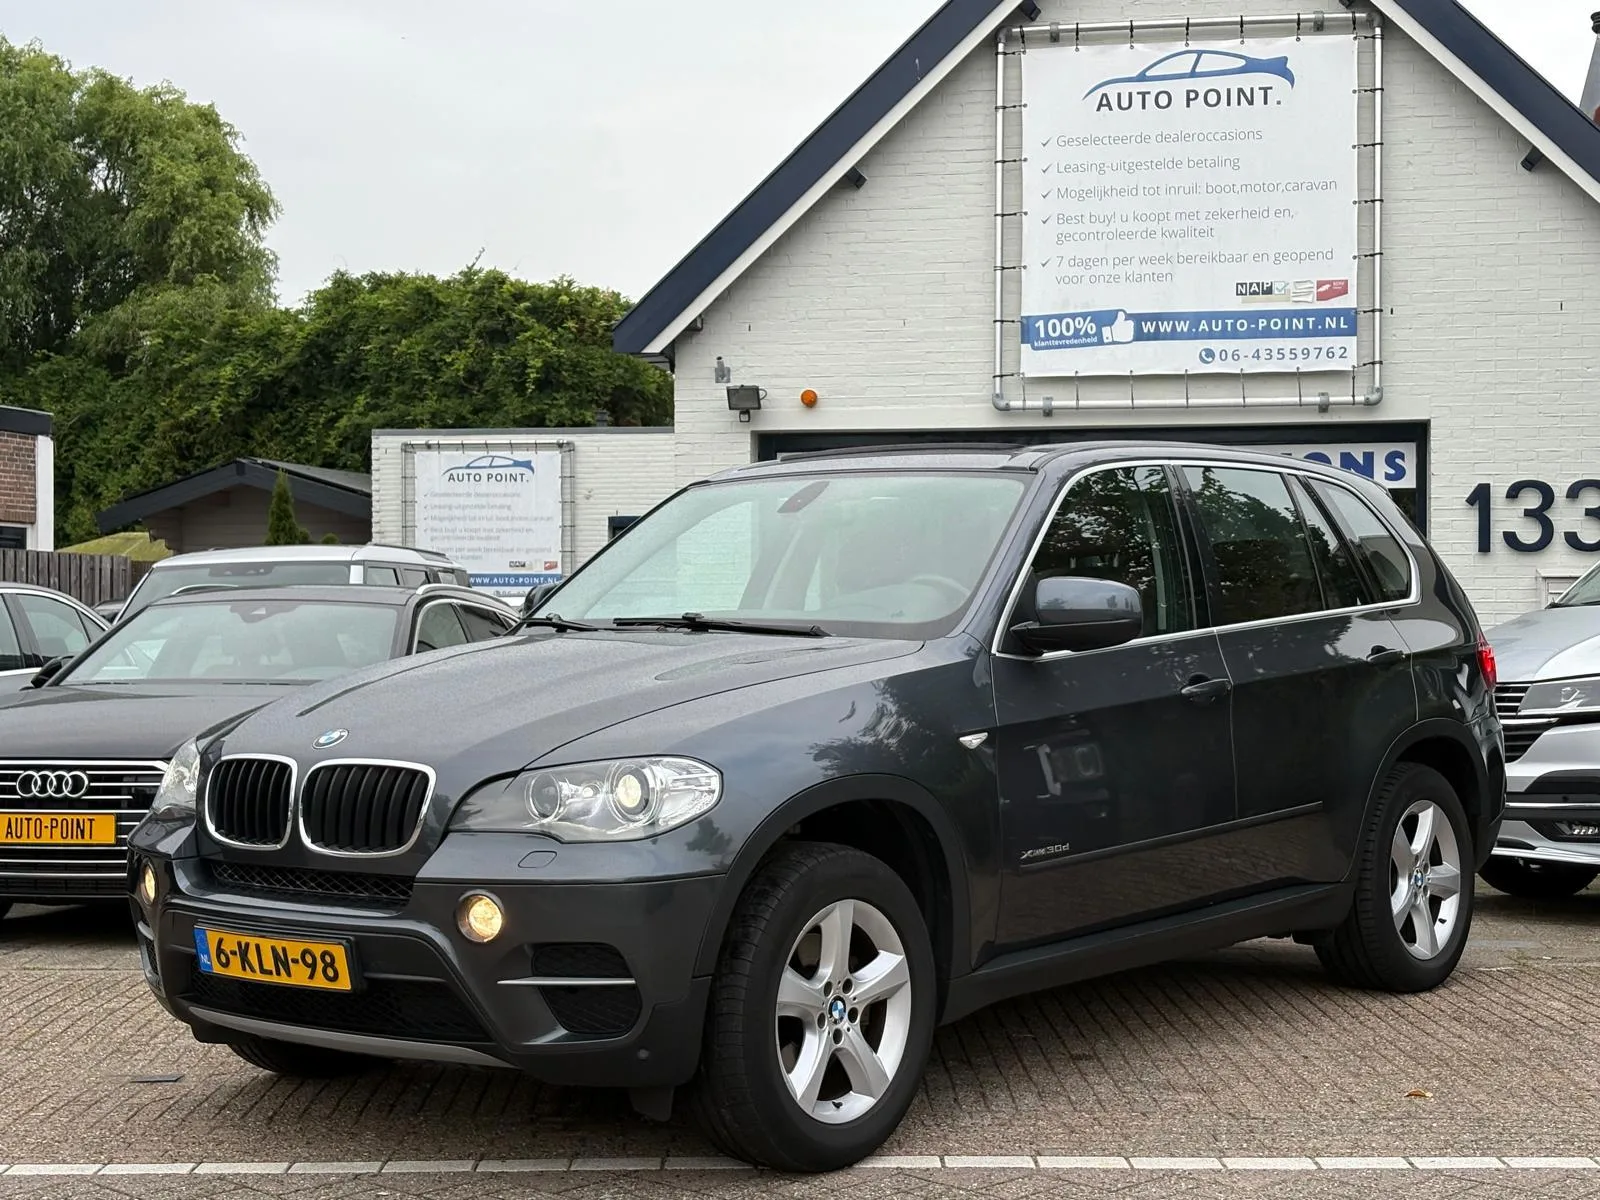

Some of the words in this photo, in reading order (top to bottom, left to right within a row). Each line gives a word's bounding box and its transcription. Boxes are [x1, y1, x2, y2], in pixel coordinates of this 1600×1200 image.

[1095, 90, 1173, 112] AUTO
[1056, 131, 1151, 148] Geselecteerde
[1155, 129, 1263, 144] dealeroccasions
[1056, 157, 1183, 175] Leasing-uitgestelde
[1187, 156, 1240, 171] betaling
[1056, 184, 1139, 202] Mogelijkheid
[1142, 184, 1161, 197] tot
[1165, 182, 1201, 196] inruil:
[1205, 179, 1338, 196] boot,motor,caravan
[1056, 212, 1085, 225] Best
[1089, 211, 1116, 227] buy!
[1120, 214, 1129, 223] u
[1133, 209, 1171, 224] koopt
[1174, 209, 1201, 221] met
[1204, 206, 1270, 221] zekerheid
[1274, 207, 1295, 219] en,
[1056, 227, 1157, 246] gecontroleerde
[1161, 225, 1215, 239] kwaliteit
[1056, 255, 1065, 268] 7
[1067, 255, 1109, 270] dagen
[1112, 256, 1135, 269] per
[1138, 252, 1174, 265] week
[1177, 250, 1247, 265] bereikbaar
[1252, 252, 1269, 263] en
[1273, 247, 1334, 265] geopend
[1055, 274, 1086, 285] voor
[1088, 273, 1121, 284] onze
[1125, 270, 1173, 283] klanten
[1236, 281, 1272, 296] NAP
[1034, 316, 1097, 338] 100%
[1141, 316, 1349, 334] WWW.AUTO-POINT.NL
[1219, 346, 1348, 361] 06-43559762
[447, 472, 482, 483] AUTO
[5, 817, 95, 840] AUTO-POINT
[215, 937, 340, 983] 6-KLN-98
